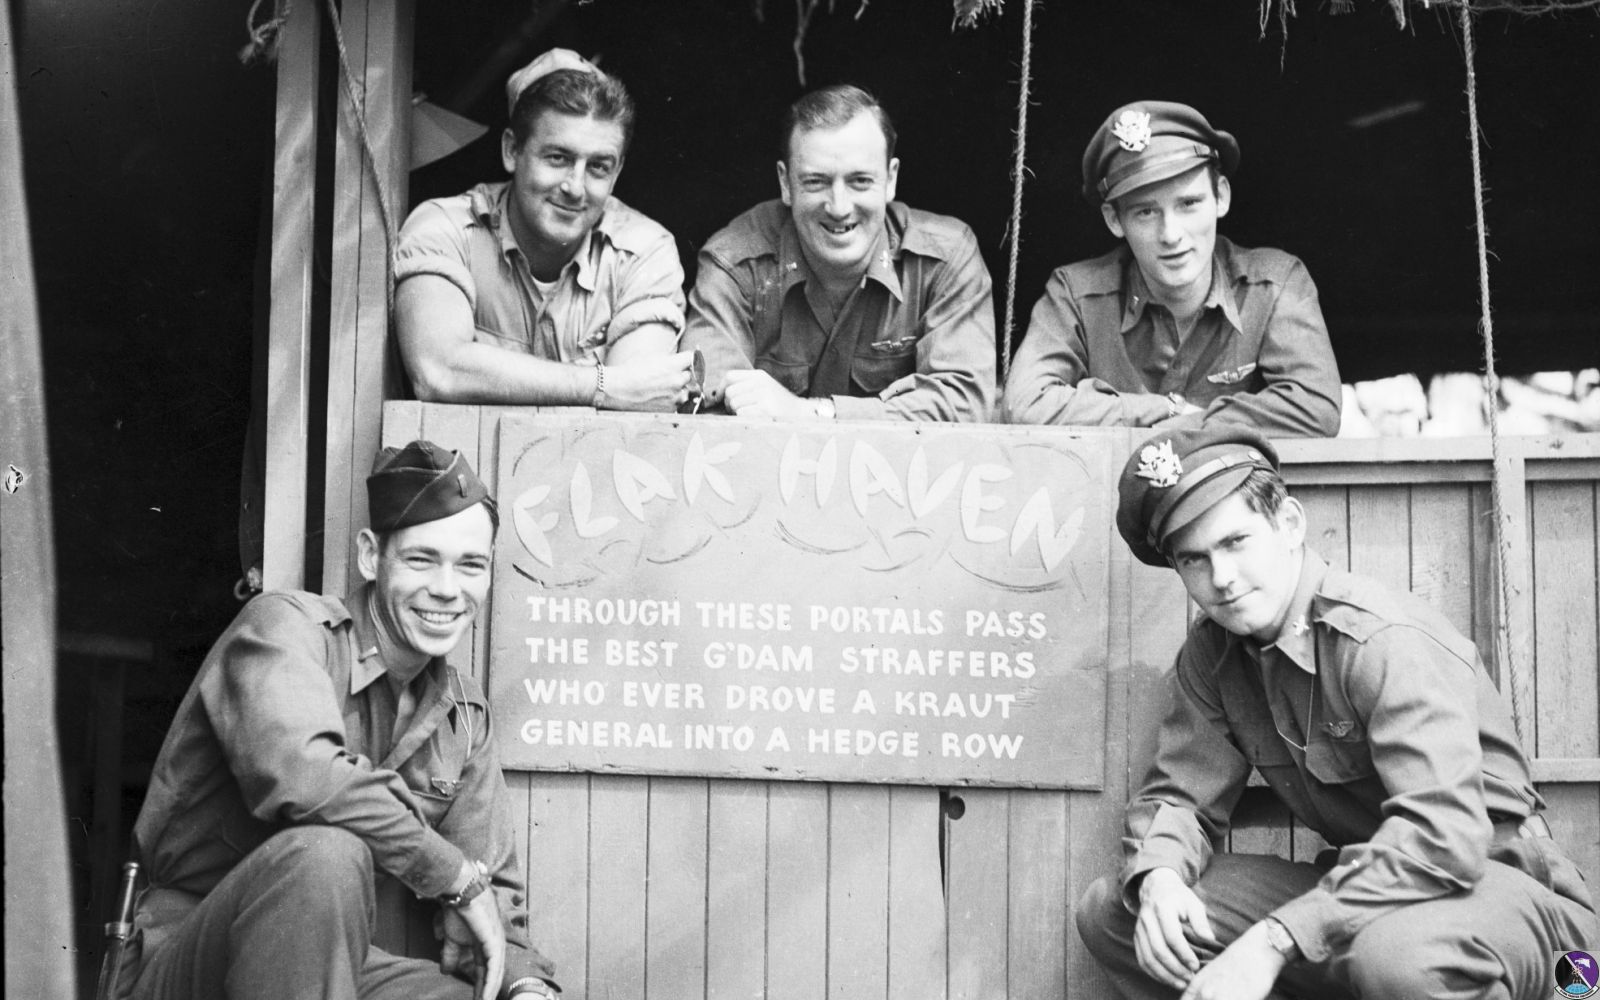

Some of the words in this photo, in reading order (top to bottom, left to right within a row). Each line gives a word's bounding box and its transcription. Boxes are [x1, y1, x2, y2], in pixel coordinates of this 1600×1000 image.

[513, 431, 742, 568] FLAK
[778, 432, 1086, 573] HAVEN
[527, 596, 680, 625] THROUGH
[697, 603, 791, 630] THESE
[812, 606, 943, 635] PORTALS
[967, 611, 1046, 639] PASS
[526, 638, 588, 663] THE
[606, 640, 678, 666] BEST
[840, 648, 1035, 678] STRAFFERS
[524, 679, 604, 705] WHO
[624, 682, 704, 708] EVER
[727, 686, 834, 712] DROVE
[853, 690, 875, 713] A
[896, 692, 1016, 718] KRAUT
[521, 719, 672, 747] GENERAL
[685, 725, 754, 750] INTO
[766, 728, 789, 751] A
[809, 729, 919, 757] HEDGE
[942, 733, 1024, 759] ROW
